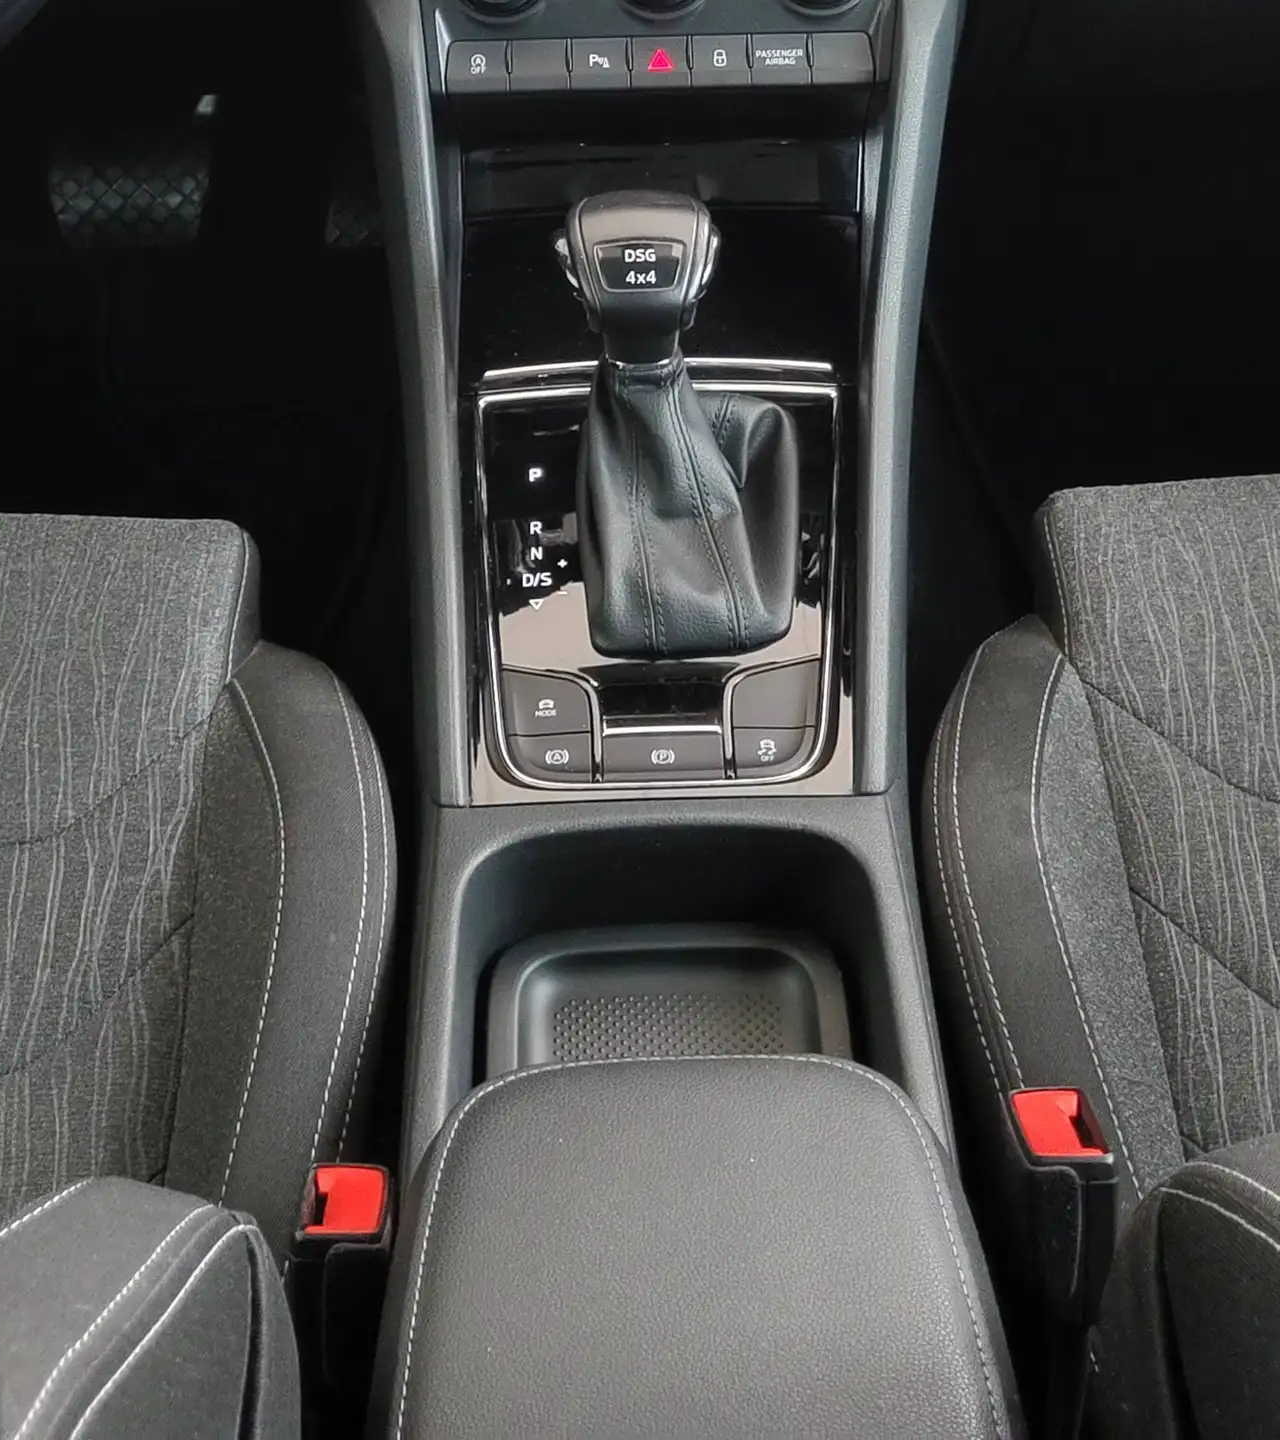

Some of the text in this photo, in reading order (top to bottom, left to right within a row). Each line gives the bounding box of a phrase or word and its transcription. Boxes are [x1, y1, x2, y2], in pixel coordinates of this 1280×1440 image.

[755, 49, 804, 60] PASSENGER
[764, 57, 796, 67] AIRBAG
[470, 66, 486, 75] OFF
[624, 248, 657, 263] DSG
[625, 269, 657, 285] 4x4
[528, 467, 543, 482] P
[530, 521, 542, 535] R
[530, 546, 543, 560] N
[522, 572, 552, 588] D/S
[535, 709, 557, 718] MODE
